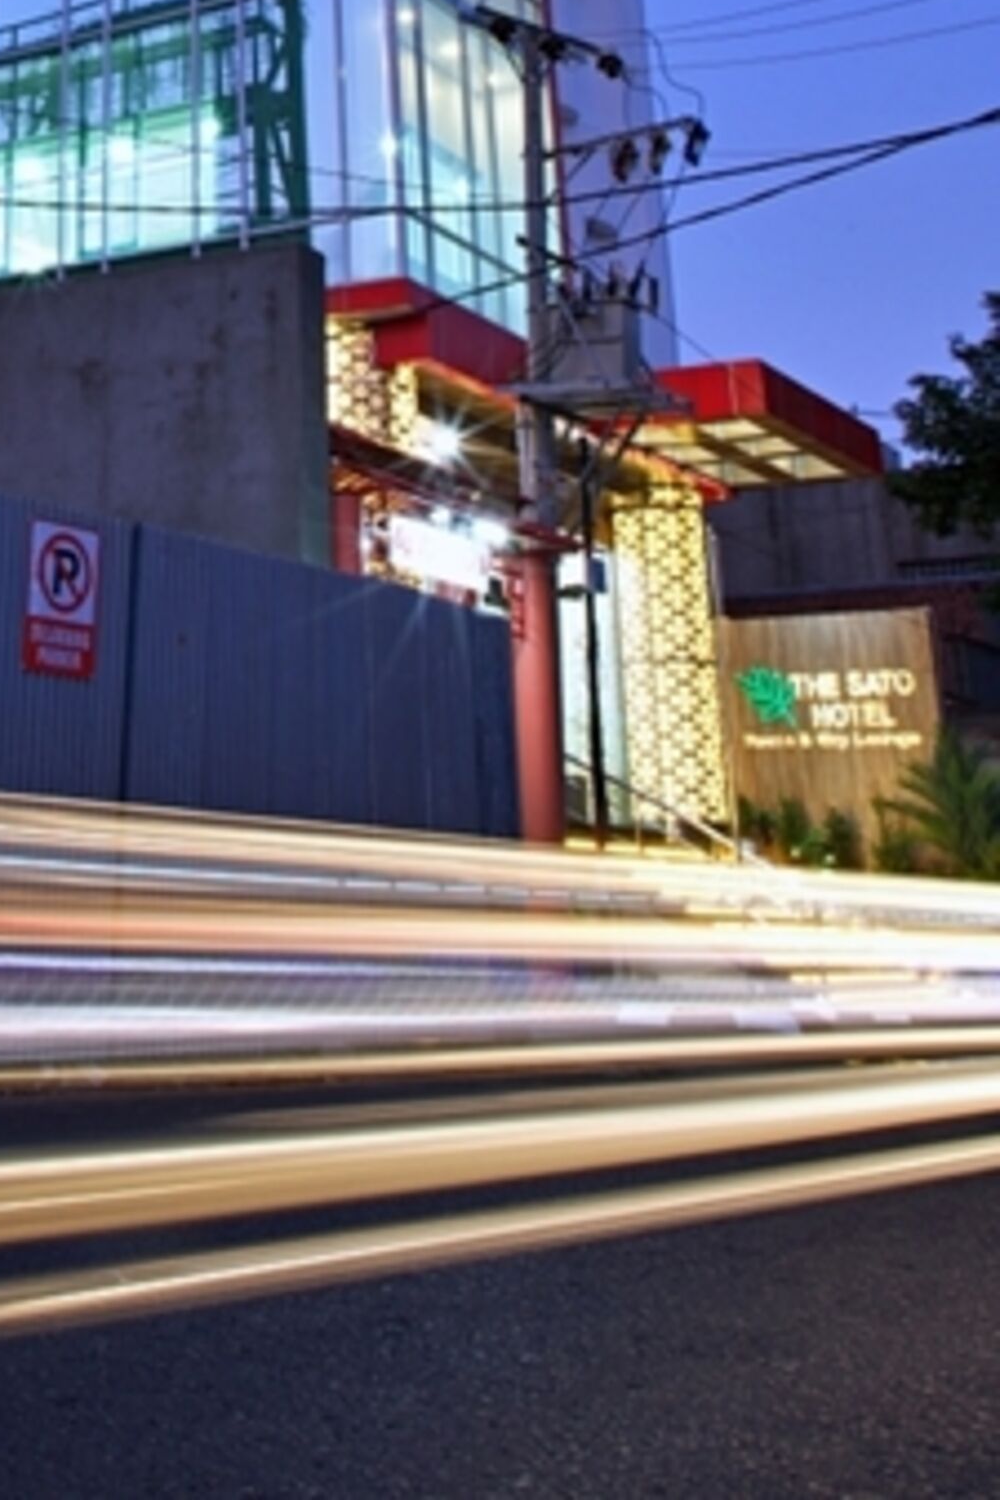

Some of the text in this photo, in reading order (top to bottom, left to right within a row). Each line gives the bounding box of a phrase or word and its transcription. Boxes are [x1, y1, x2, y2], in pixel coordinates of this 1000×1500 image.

[789, 668, 916, 699] THE SATO
[811, 700, 898, 728] HOTEL
